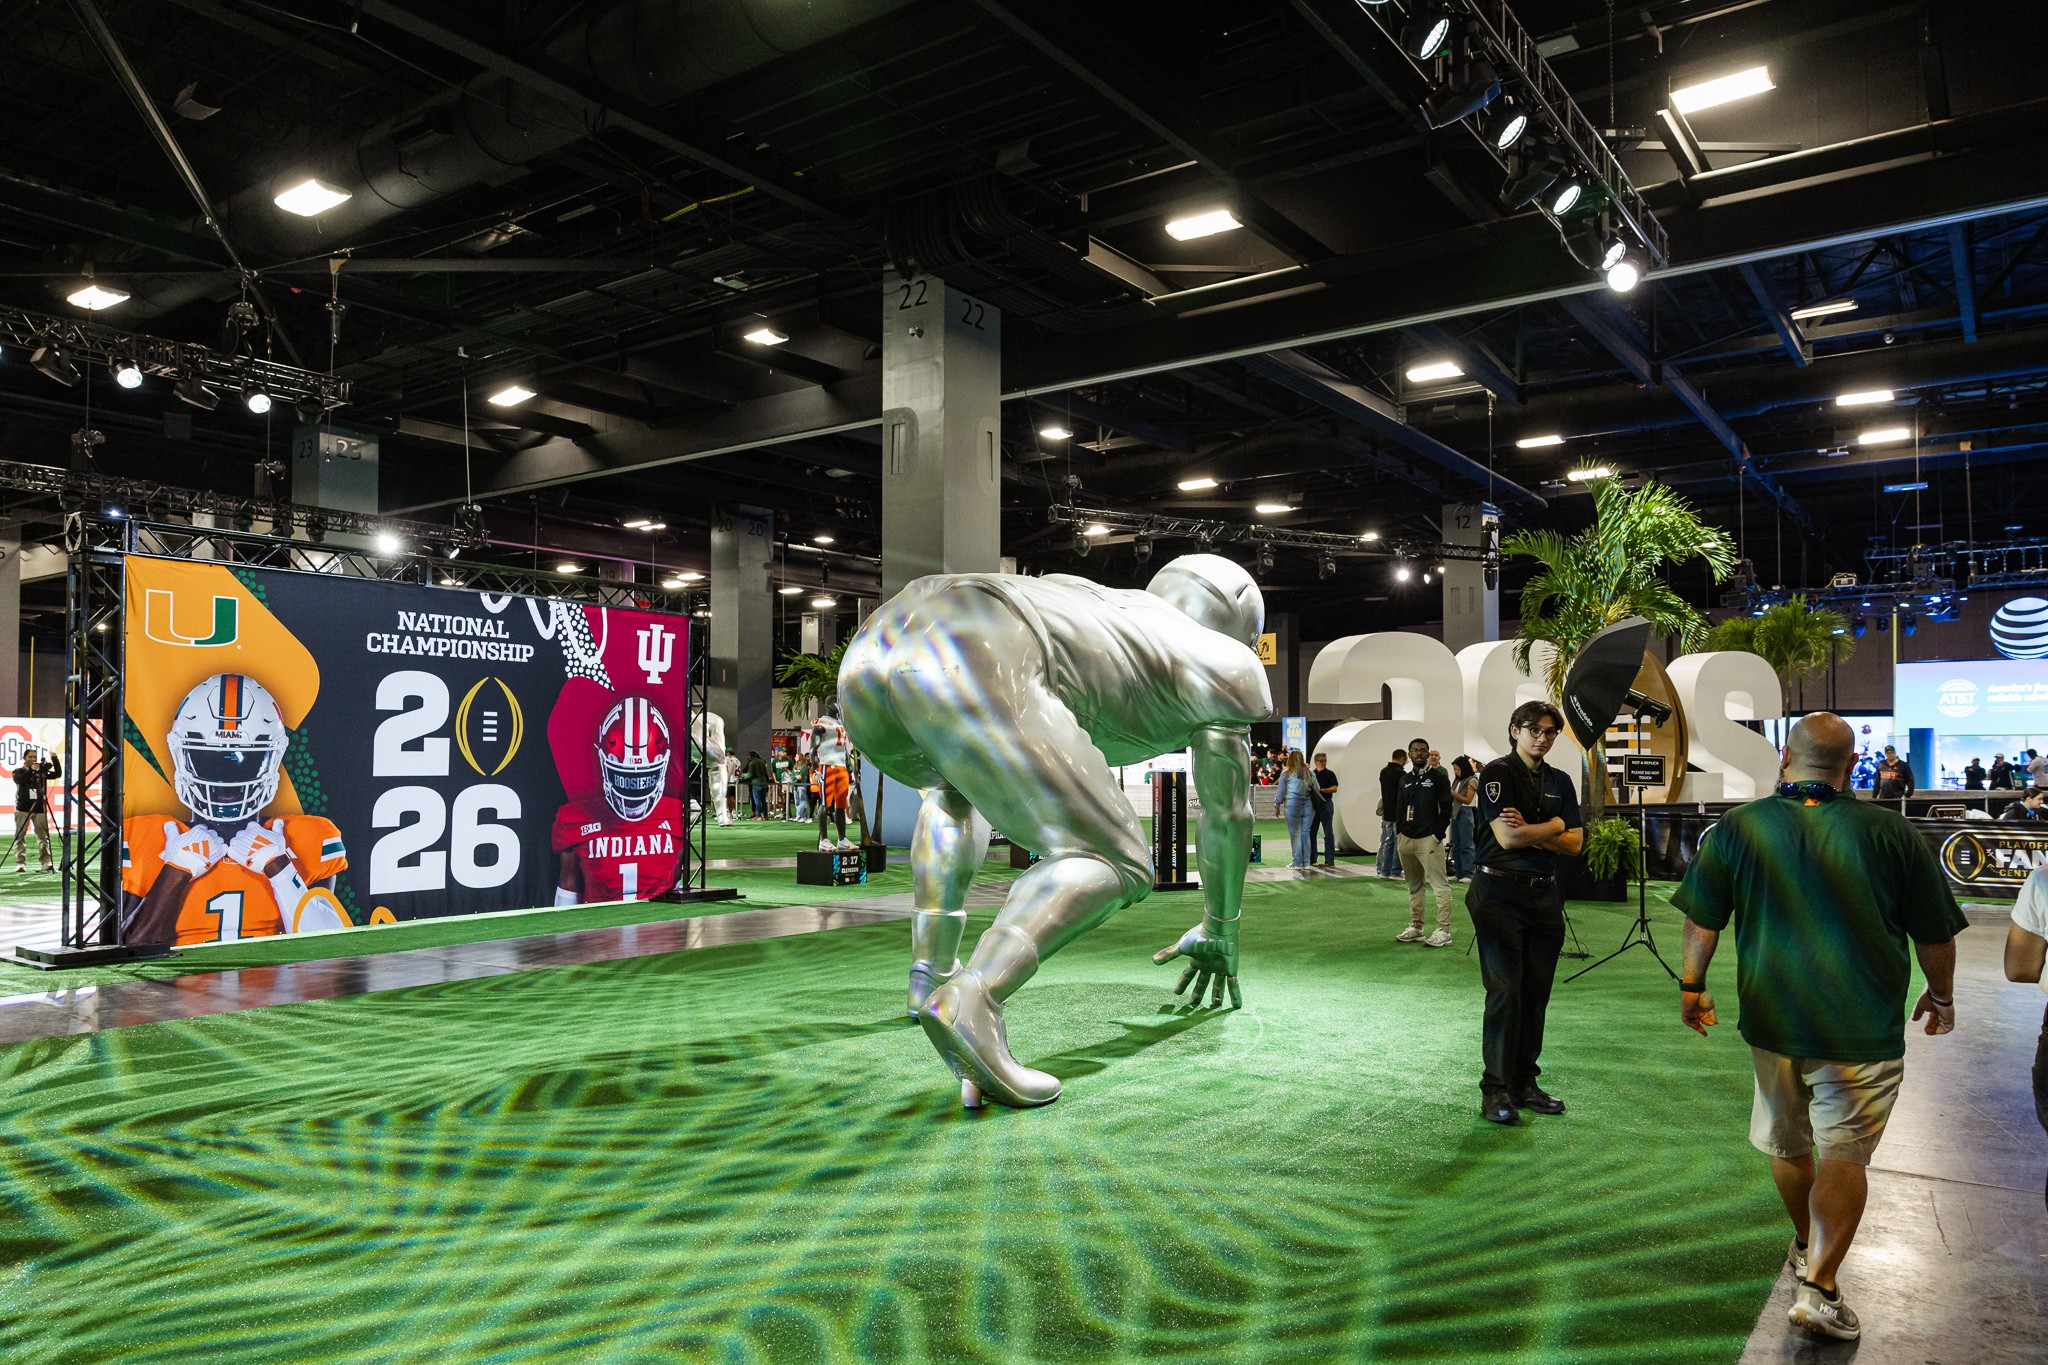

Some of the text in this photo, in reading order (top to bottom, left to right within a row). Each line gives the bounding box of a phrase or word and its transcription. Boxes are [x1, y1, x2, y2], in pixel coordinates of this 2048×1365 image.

[899, 279, 928, 311] 22
[961, 298, 985, 331] 22
[299, 440, 313, 459] 23
[336, 439, 362, 460] 23
[718, 517, 732, 532] 20
[748, 521, 764, 537] 20
[1455, 515, 1471, 530] 12
[145, 588, 239, 647] U
[397, 610, 510, 639] NATIONAL
[366, 632, 535, 662] CHAMPIONSHIP
[1938, 691, 1977, 705] AT&T
[1575, 702, 1594, 727] Profoto
[614, 774, 656, 790] HOOSIERS
[369, 783, 522, 895] 26
[588, 833, 674, 859] INDIANA
[1999, 841, 2048, 849] PLAYOFF
[1995, 848, 2048, 869] FAN
[841, 866, 859, 874] CLEMSON
[619, 862, 639, 902] 1
[206, 890, 254, 942] 1
[1819, 1302, 1838, 1319] HOKA
